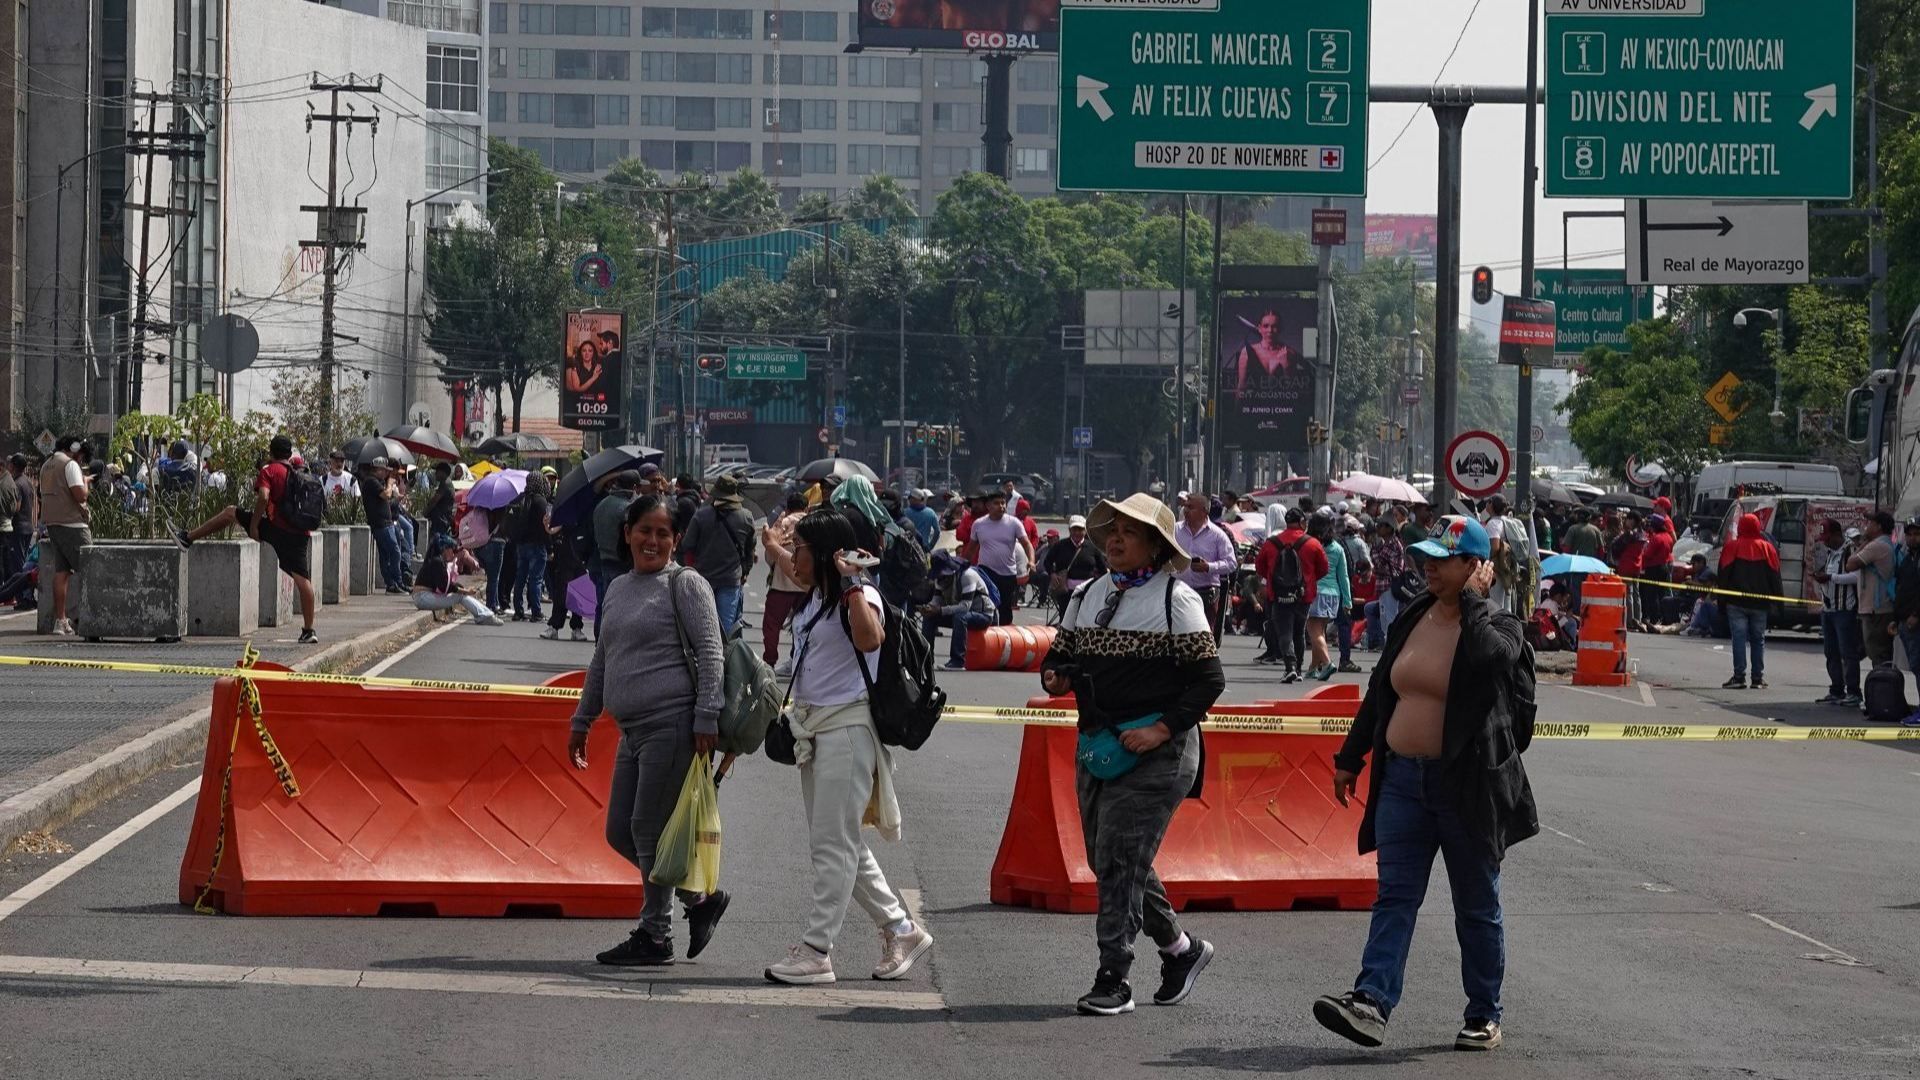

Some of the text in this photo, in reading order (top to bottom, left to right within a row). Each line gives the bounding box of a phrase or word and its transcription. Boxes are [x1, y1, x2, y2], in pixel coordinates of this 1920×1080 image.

[1561, 0, 1686, 10] AV UNIVERSIDAD
[965, 31, 1040, 49] GLOBAL
[1131, 31, 1292, 66] GABRIEL MANCERA
[1321, 40, 1336, 63] 2
[1579, 43, 1587, 64] 1
[1620, 38, 1784, 71] AV MEXICO-COYOACAN
[1131, 84, 1291, 120] AV FELIX CUEVAS
[1319, 93, 1337, 115] 7
[1571, 90, 1772, 123] DIVISION DEL NTE
[1145, 145, 1308, 168] HOSP 20 DE NOVIEMBRE
[1575, 147, 1593, 169] 8
[1620, 142, 1780, 176] AV POPOCATEPETL
[1663, 257, 1805, 276] Real de Mayorazgo
[1561, 307, 1589, 321] Centro
[1591, 306, 1622, 321] Cultural
[1557, 329, 1627, 343] Roberto Cantoral
[749, 353, 799, 363] INSURGENTES
[746, 365, 787, 373] EJE 7 SUR
[576, 402, 608, 414] 10:09
[578, 418, 606, 426] GLOBAL
